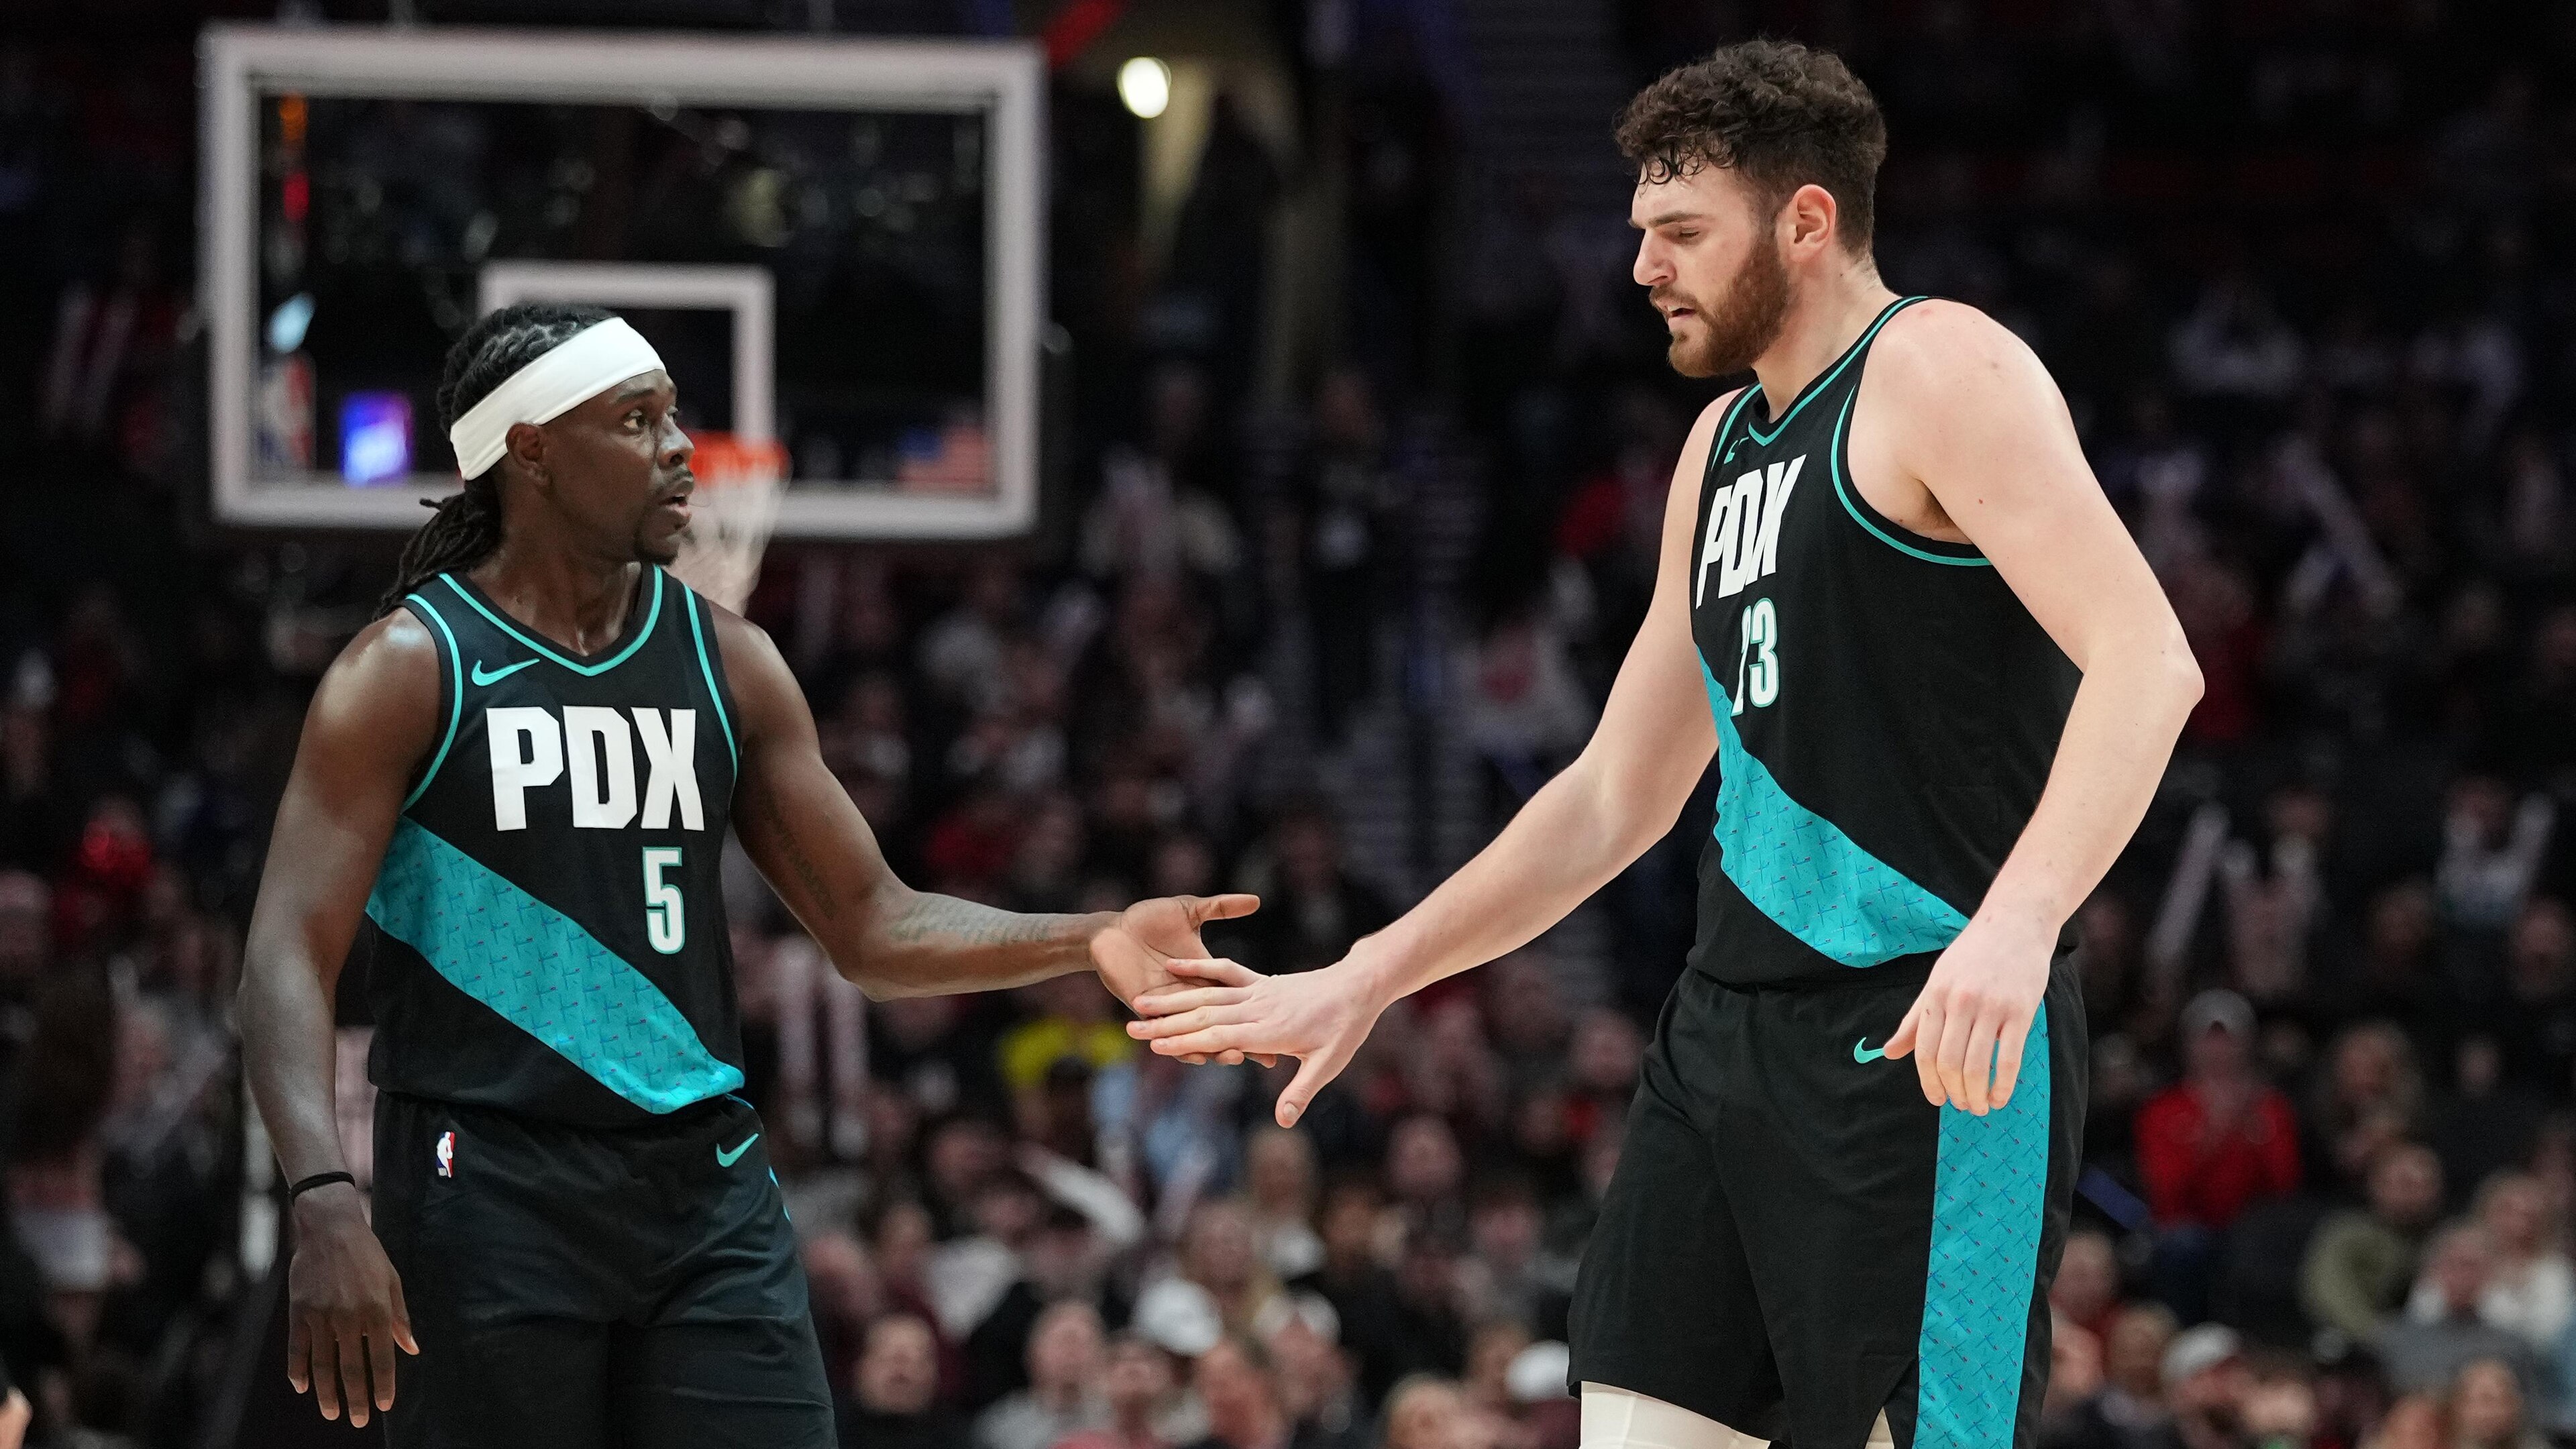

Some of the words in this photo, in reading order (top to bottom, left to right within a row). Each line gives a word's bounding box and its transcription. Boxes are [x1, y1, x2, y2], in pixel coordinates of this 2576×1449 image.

[1696, 454, 1807, 609] PDX
[486, 705, 704, 831] PDX
[642, 846, 685, 954] 5
